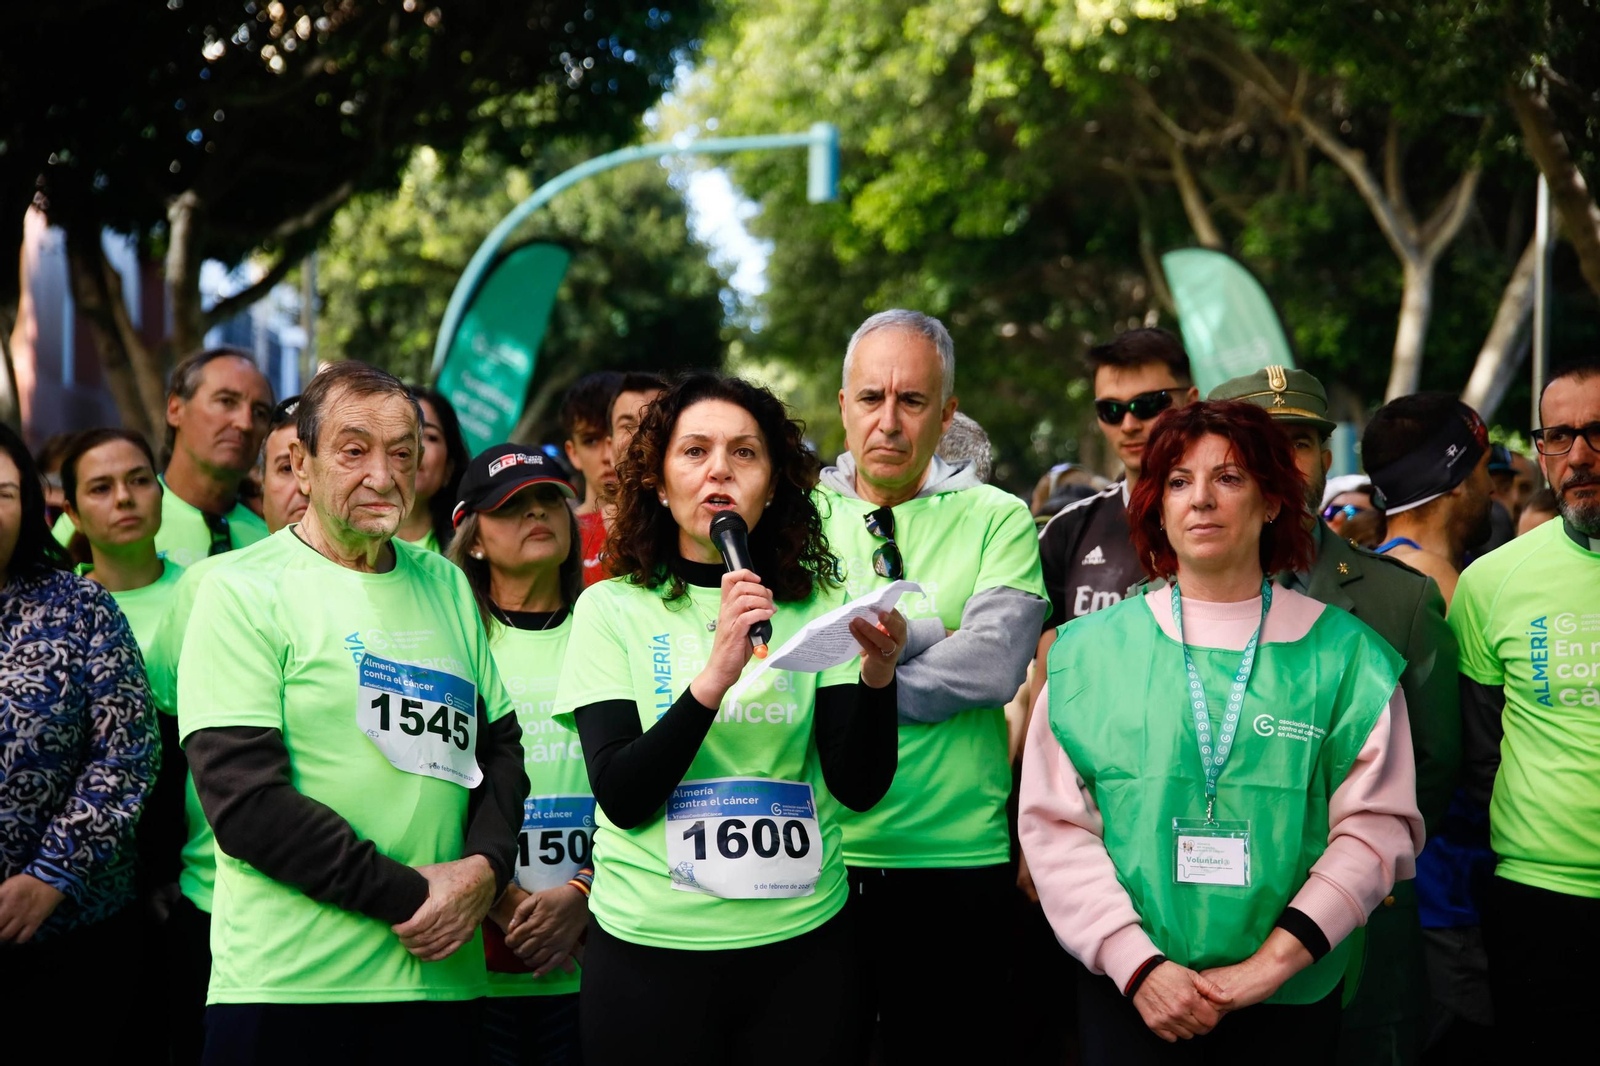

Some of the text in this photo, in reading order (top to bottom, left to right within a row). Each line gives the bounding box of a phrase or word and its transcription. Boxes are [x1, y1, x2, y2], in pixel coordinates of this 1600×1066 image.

[915, 595, 938, 613] el
[1555, 640, 1583, 657] En
[364, 658, 396, 673] Almería
[677, 657, 705, 672] En
[1526, 615, 1553, 707] ALMERÍA
[364, 669, 392, 683] contra
[393, 676, 402, 685] el
[403, 676, 434, 691] cáncer
[774, 670, 795, 693] el
[371, 693, 470, 751] 1545
[1278, 725, 1297, 733] contra
[1286, 732, 1308, 742] Almería
[673, 787, 714, 799] Almería
[673, 796, 759, 809] contra el cáncer
[532, 811, 541, 819] el
[543, 810, 573, 818] cáncer
[518, 829, 593, 867] 150
[683, 819, 810, 861] 1600
